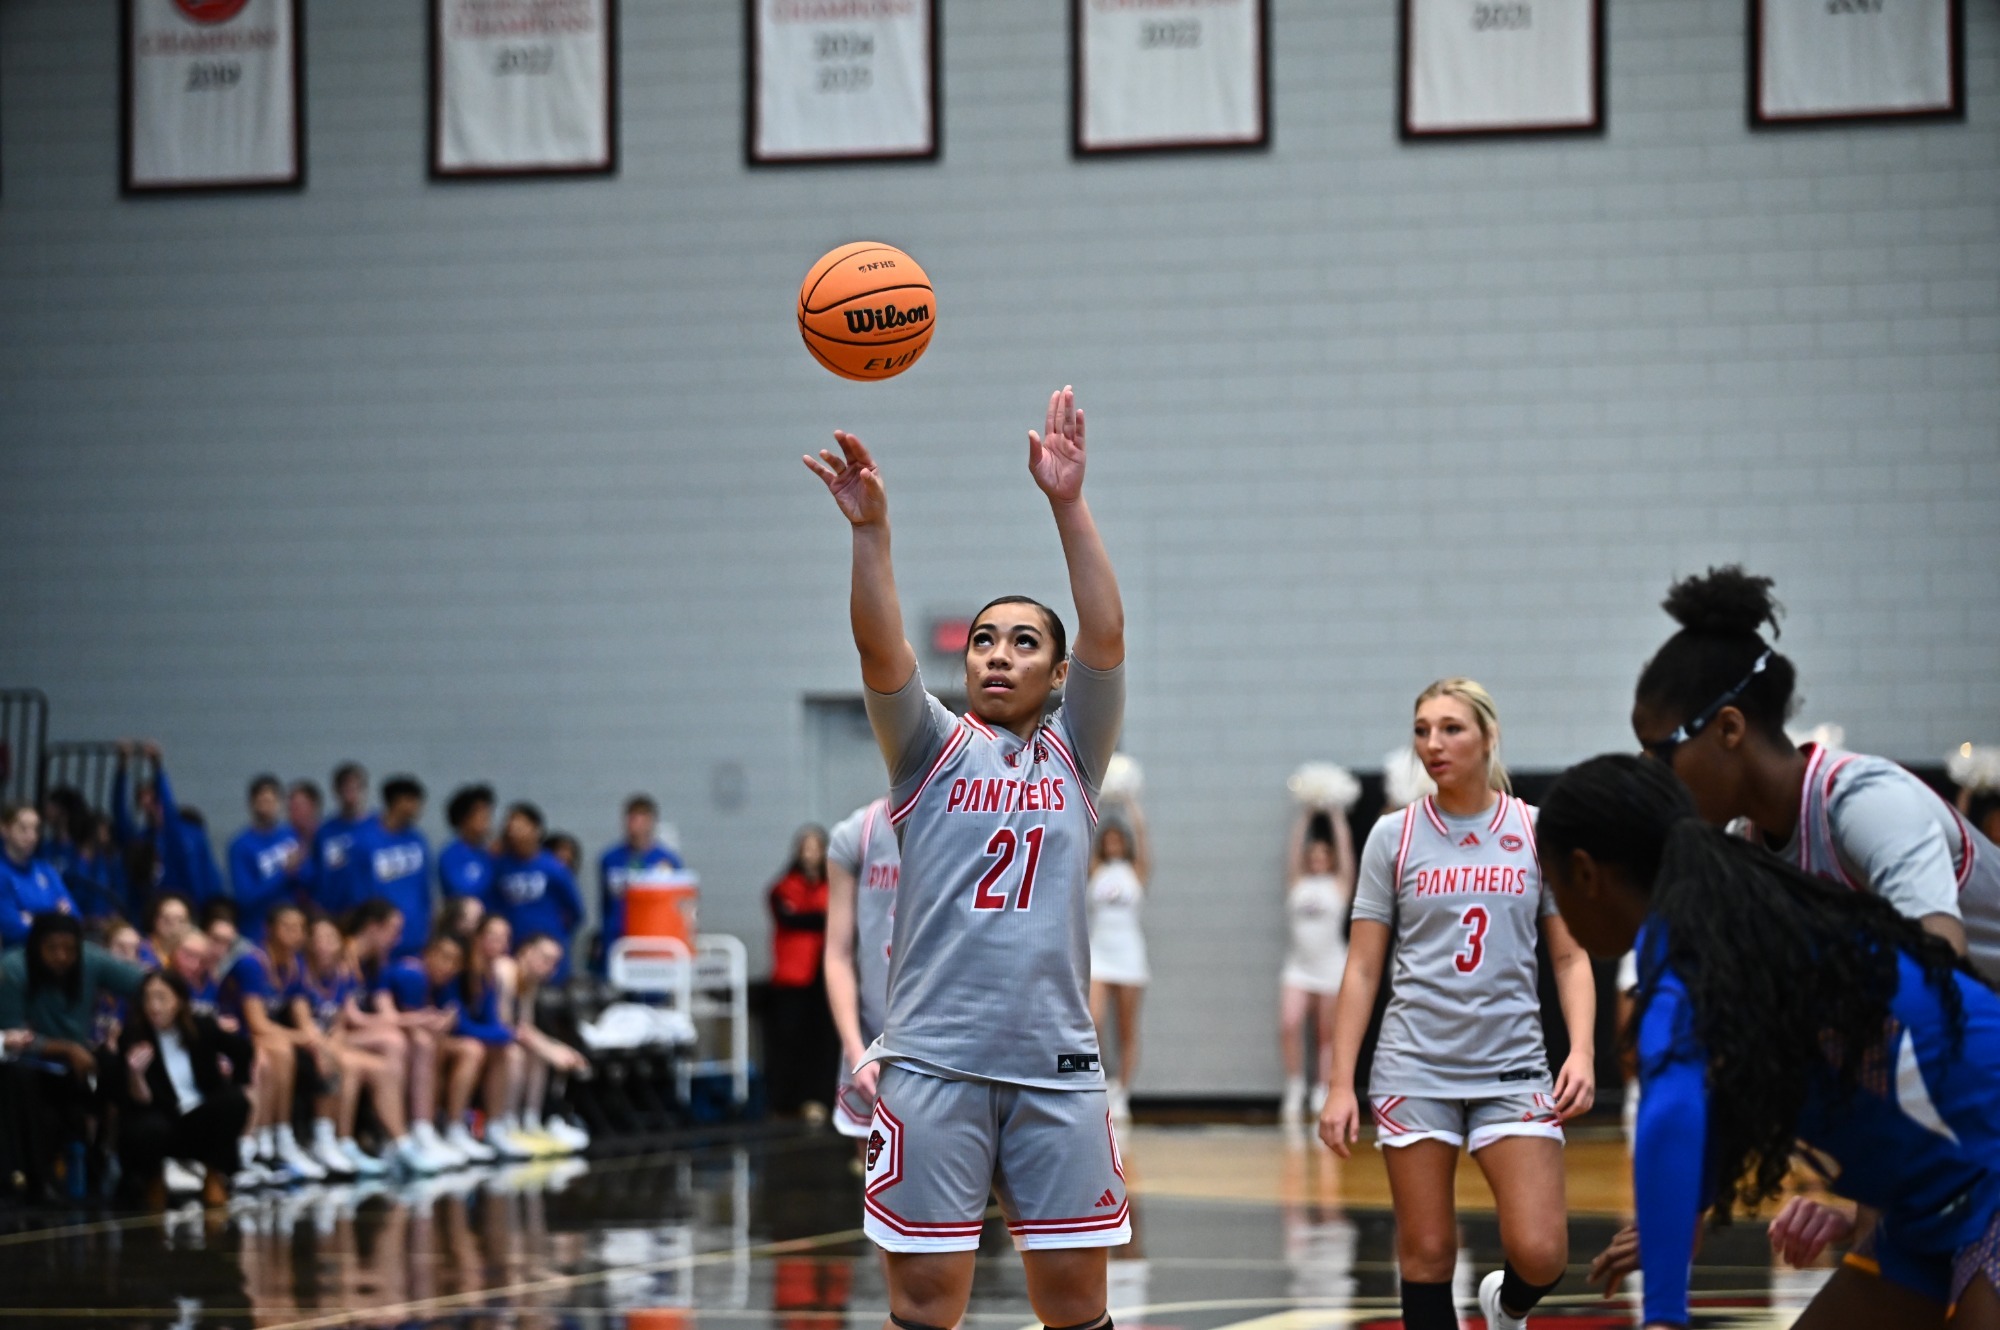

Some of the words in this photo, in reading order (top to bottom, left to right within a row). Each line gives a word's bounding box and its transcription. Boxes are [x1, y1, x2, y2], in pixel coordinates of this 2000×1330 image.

[867, 260, 896, 271] NFHS
[844, 304, 929, 334] Wilson
[970, 824, 1046, 912] 21
[1415, 864, 1528, 897] PANTHERS
[1452, 904, 1491, 976] 3
